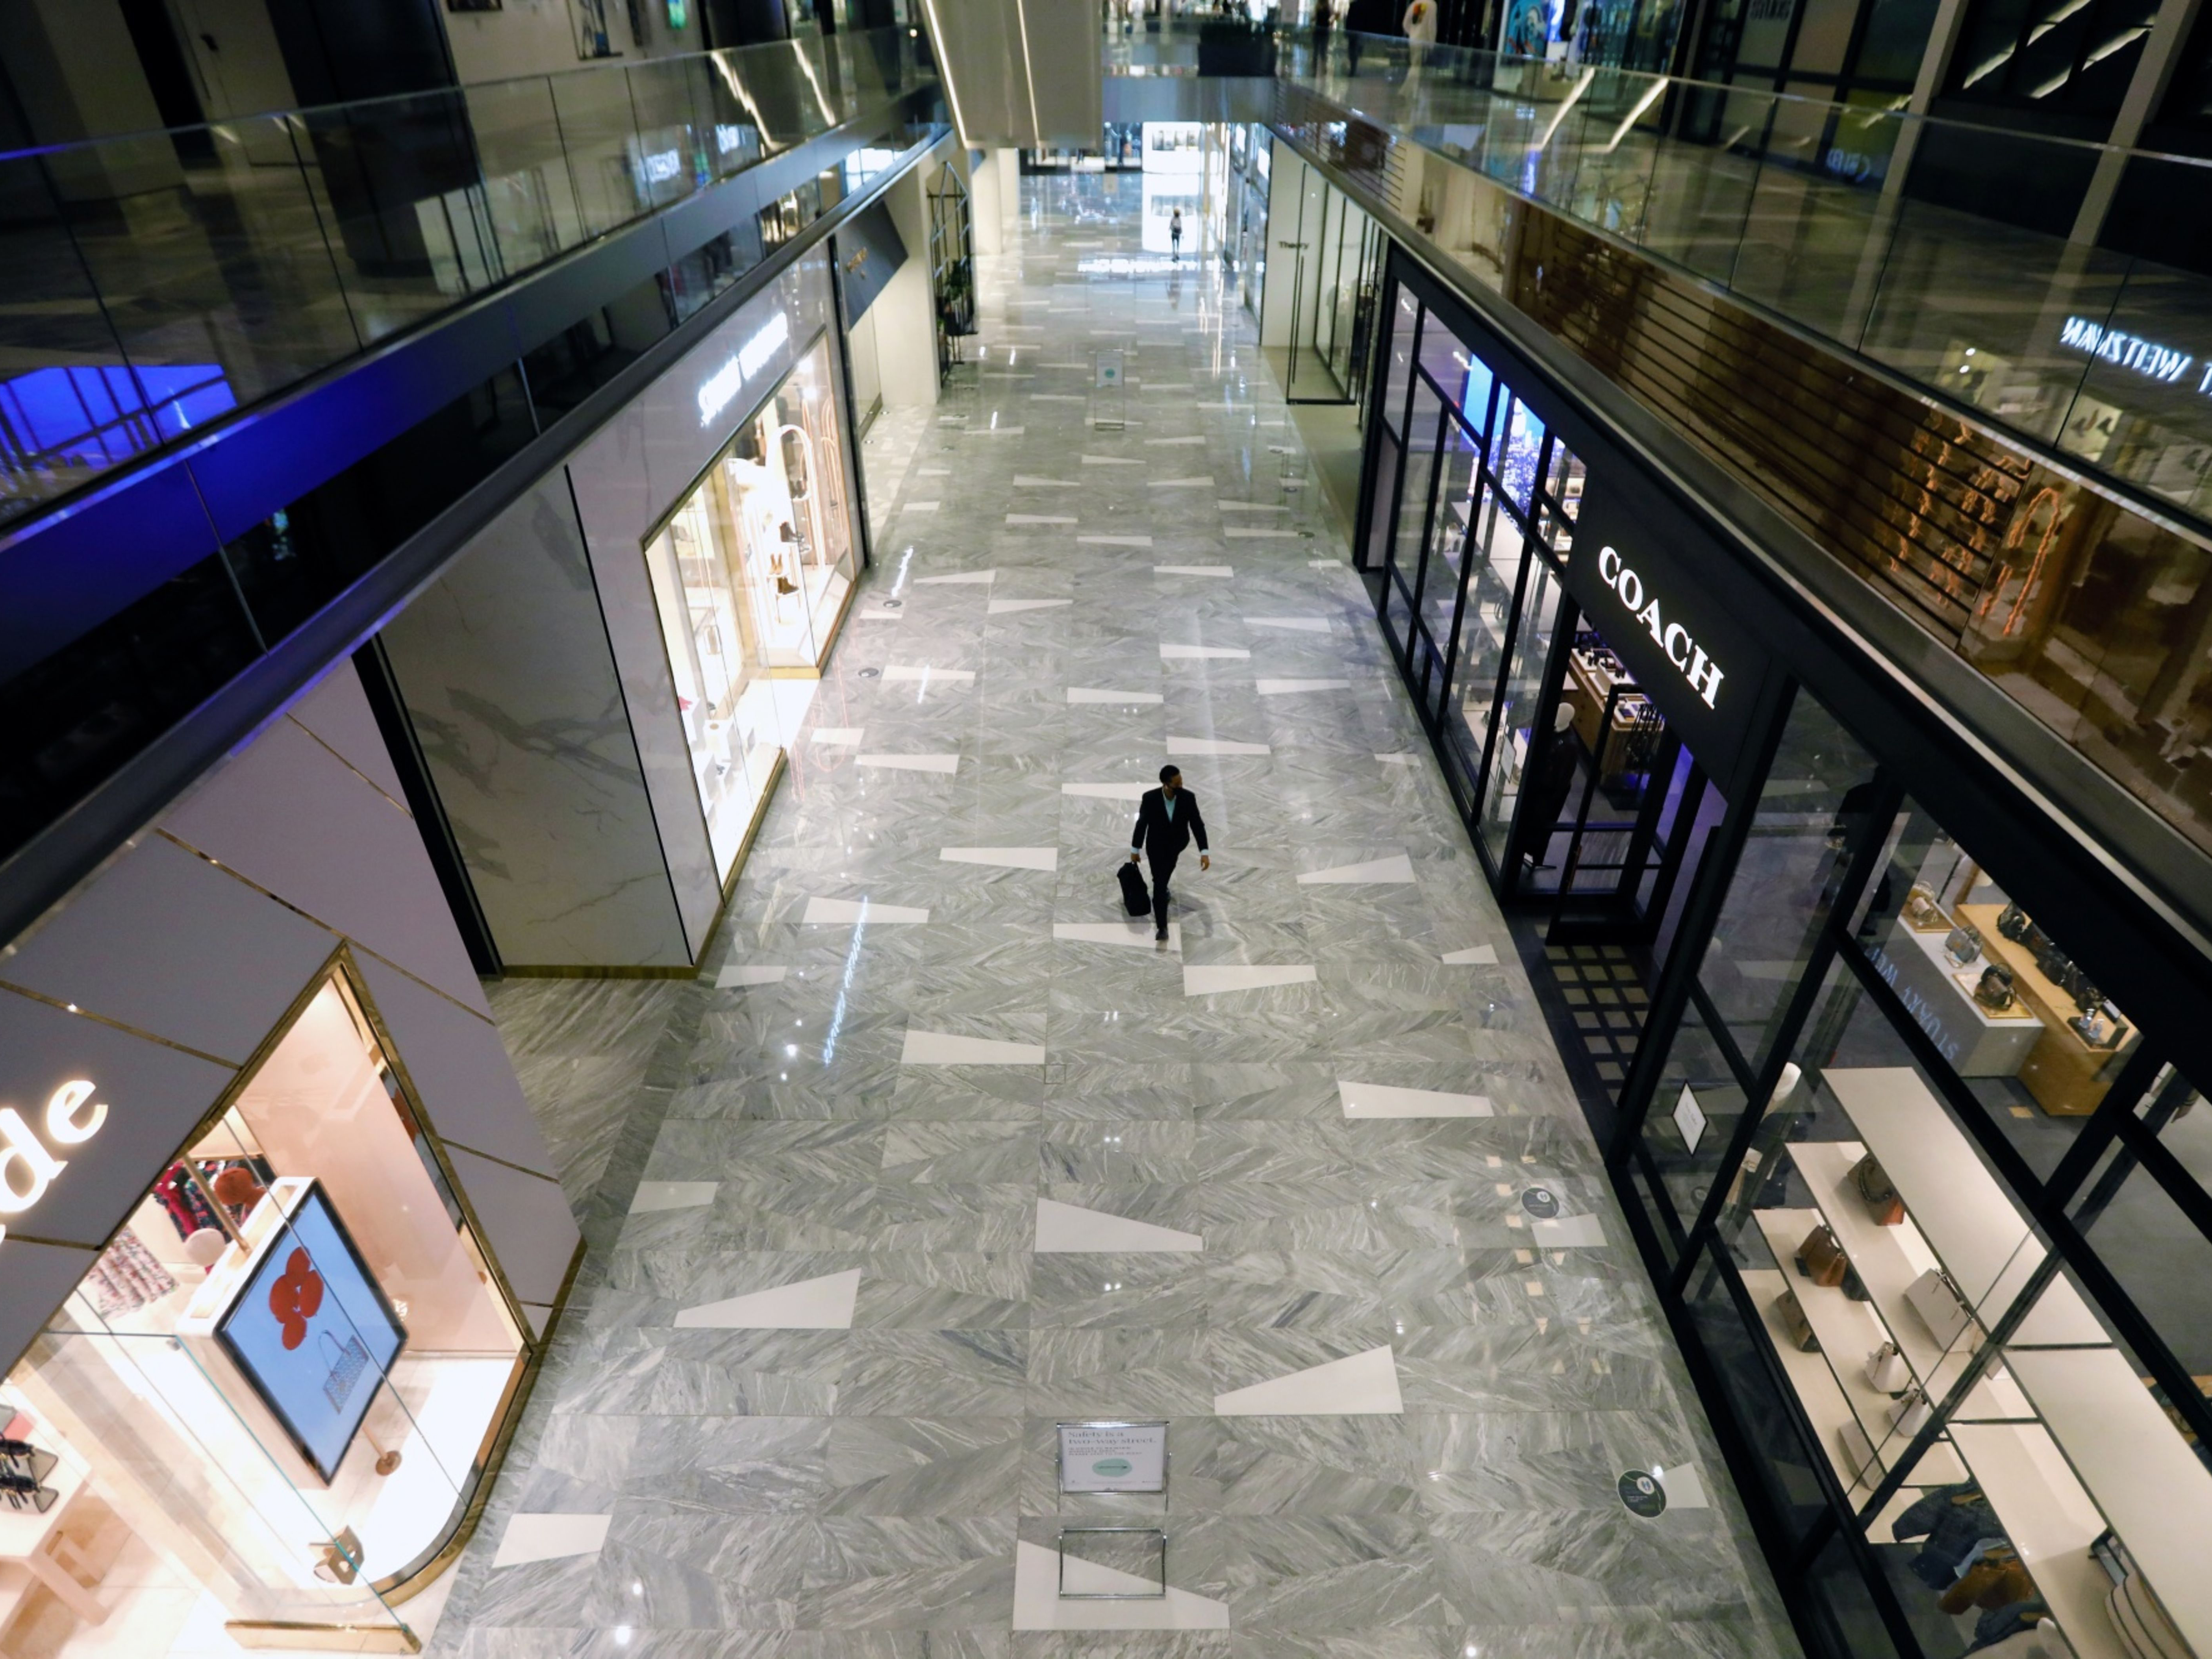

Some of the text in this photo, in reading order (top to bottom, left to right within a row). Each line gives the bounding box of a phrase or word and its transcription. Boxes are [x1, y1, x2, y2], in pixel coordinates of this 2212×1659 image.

[1278, 241, 1309, 250] Theory
[1599, 546, 1725, 714] COACH
[0, 1080, 108, 1245] de
